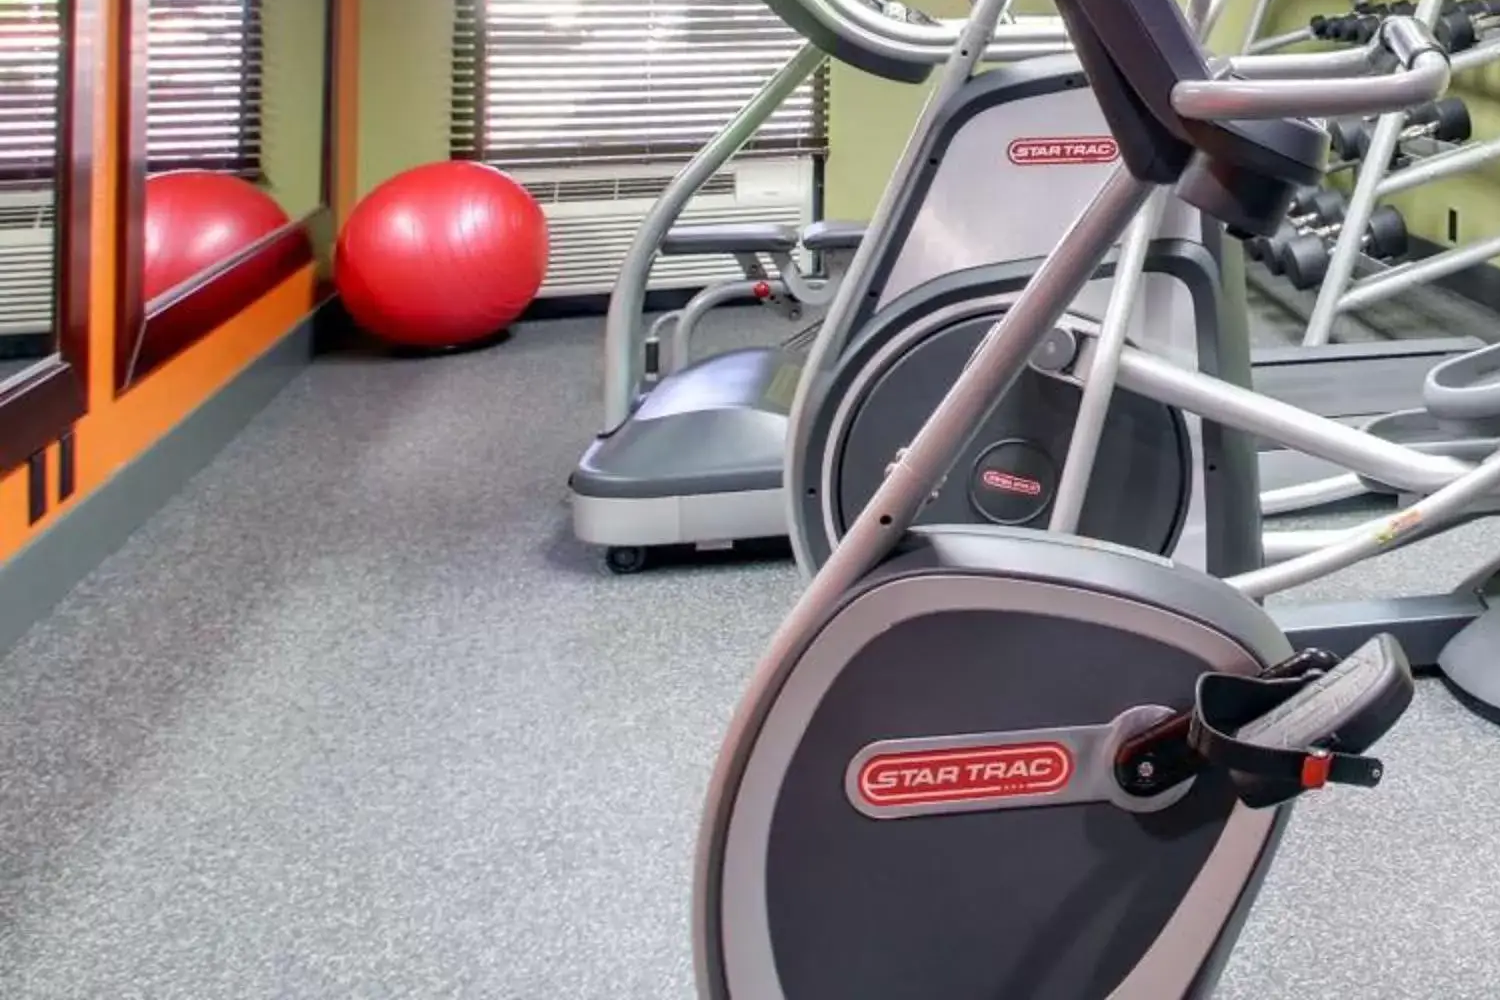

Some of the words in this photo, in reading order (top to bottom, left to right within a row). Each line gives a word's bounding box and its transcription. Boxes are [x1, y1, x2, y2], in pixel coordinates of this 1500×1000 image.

[1015, 145, 1060, 157] STAR
[1063, 143, 1111, 156] TRAC
[872, 765, 960, 789] STAR
[964, 758, 1053, 781] TRAC
